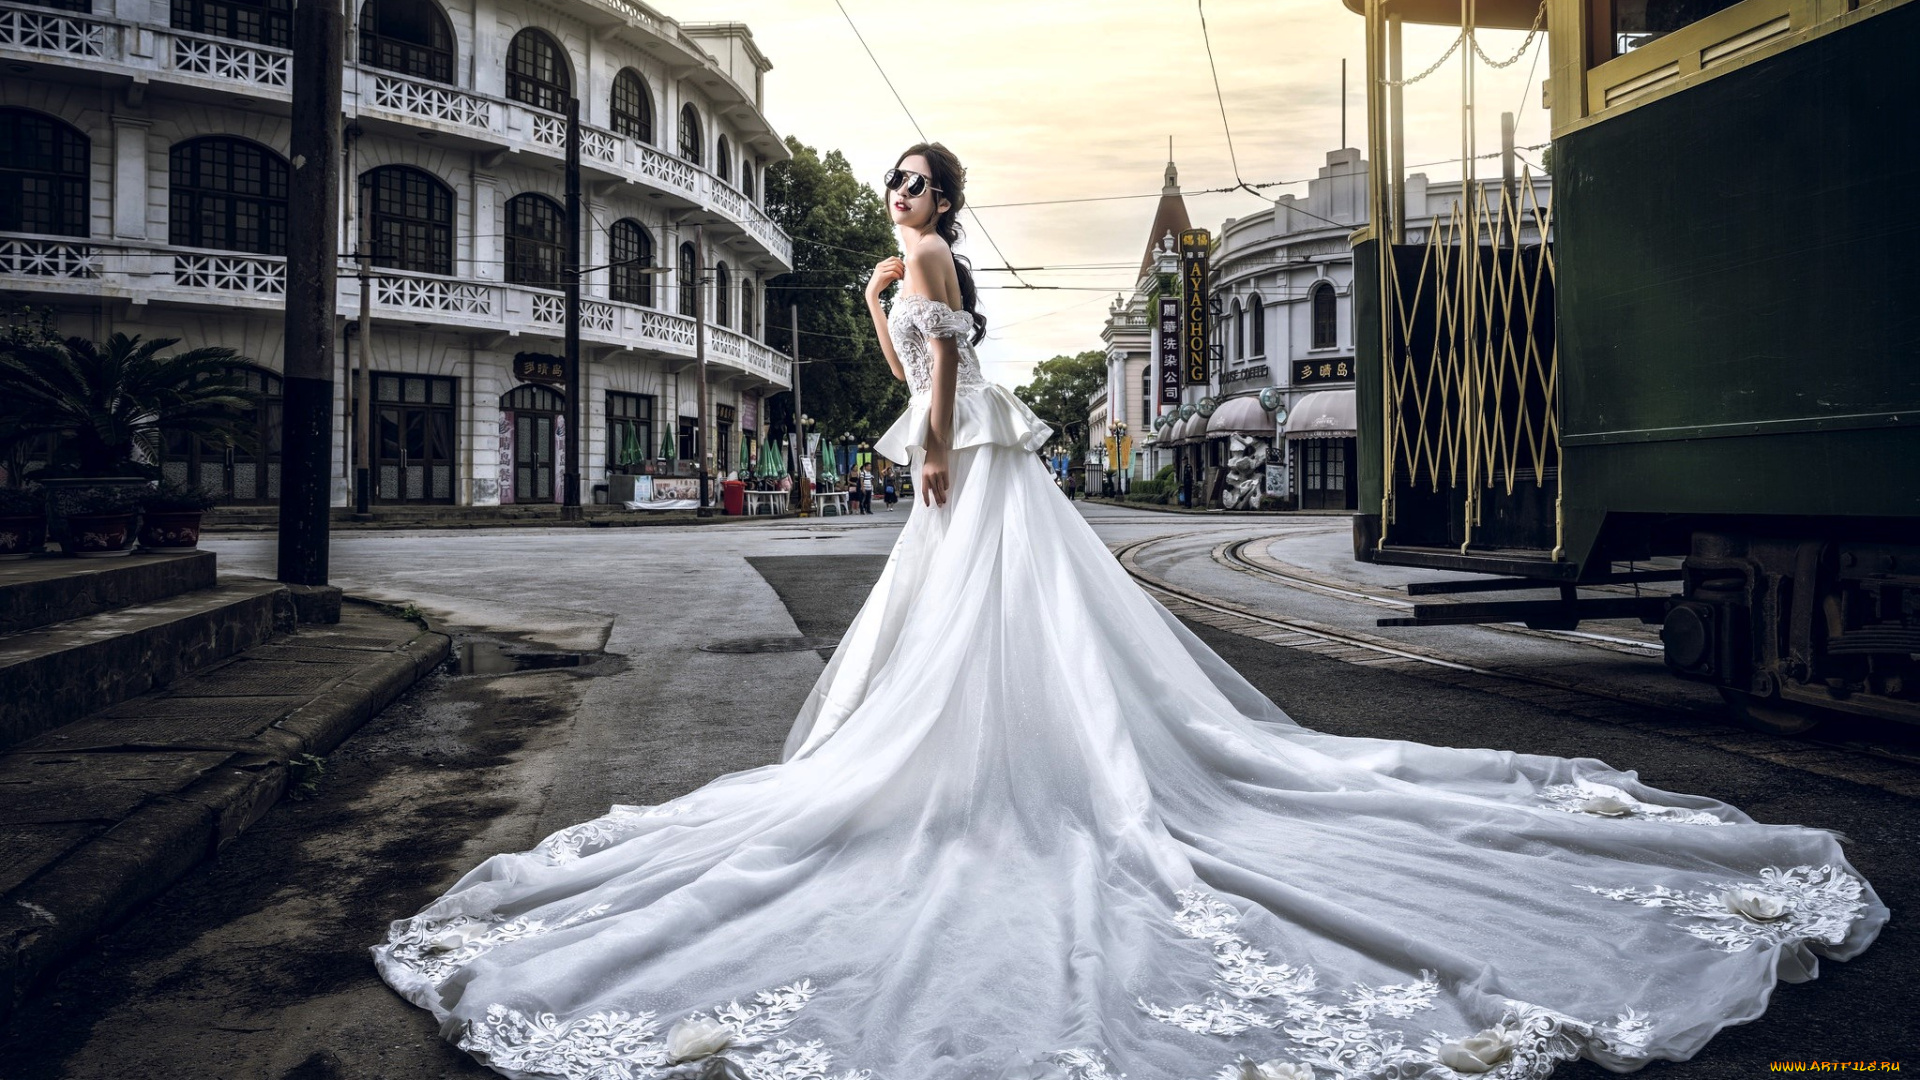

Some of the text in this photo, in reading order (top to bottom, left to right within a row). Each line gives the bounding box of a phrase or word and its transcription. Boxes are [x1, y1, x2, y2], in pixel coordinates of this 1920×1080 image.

[1190, 262, 1204, 380] AYACHONG
[1301, 361, 1356, 379] 多晴岛
